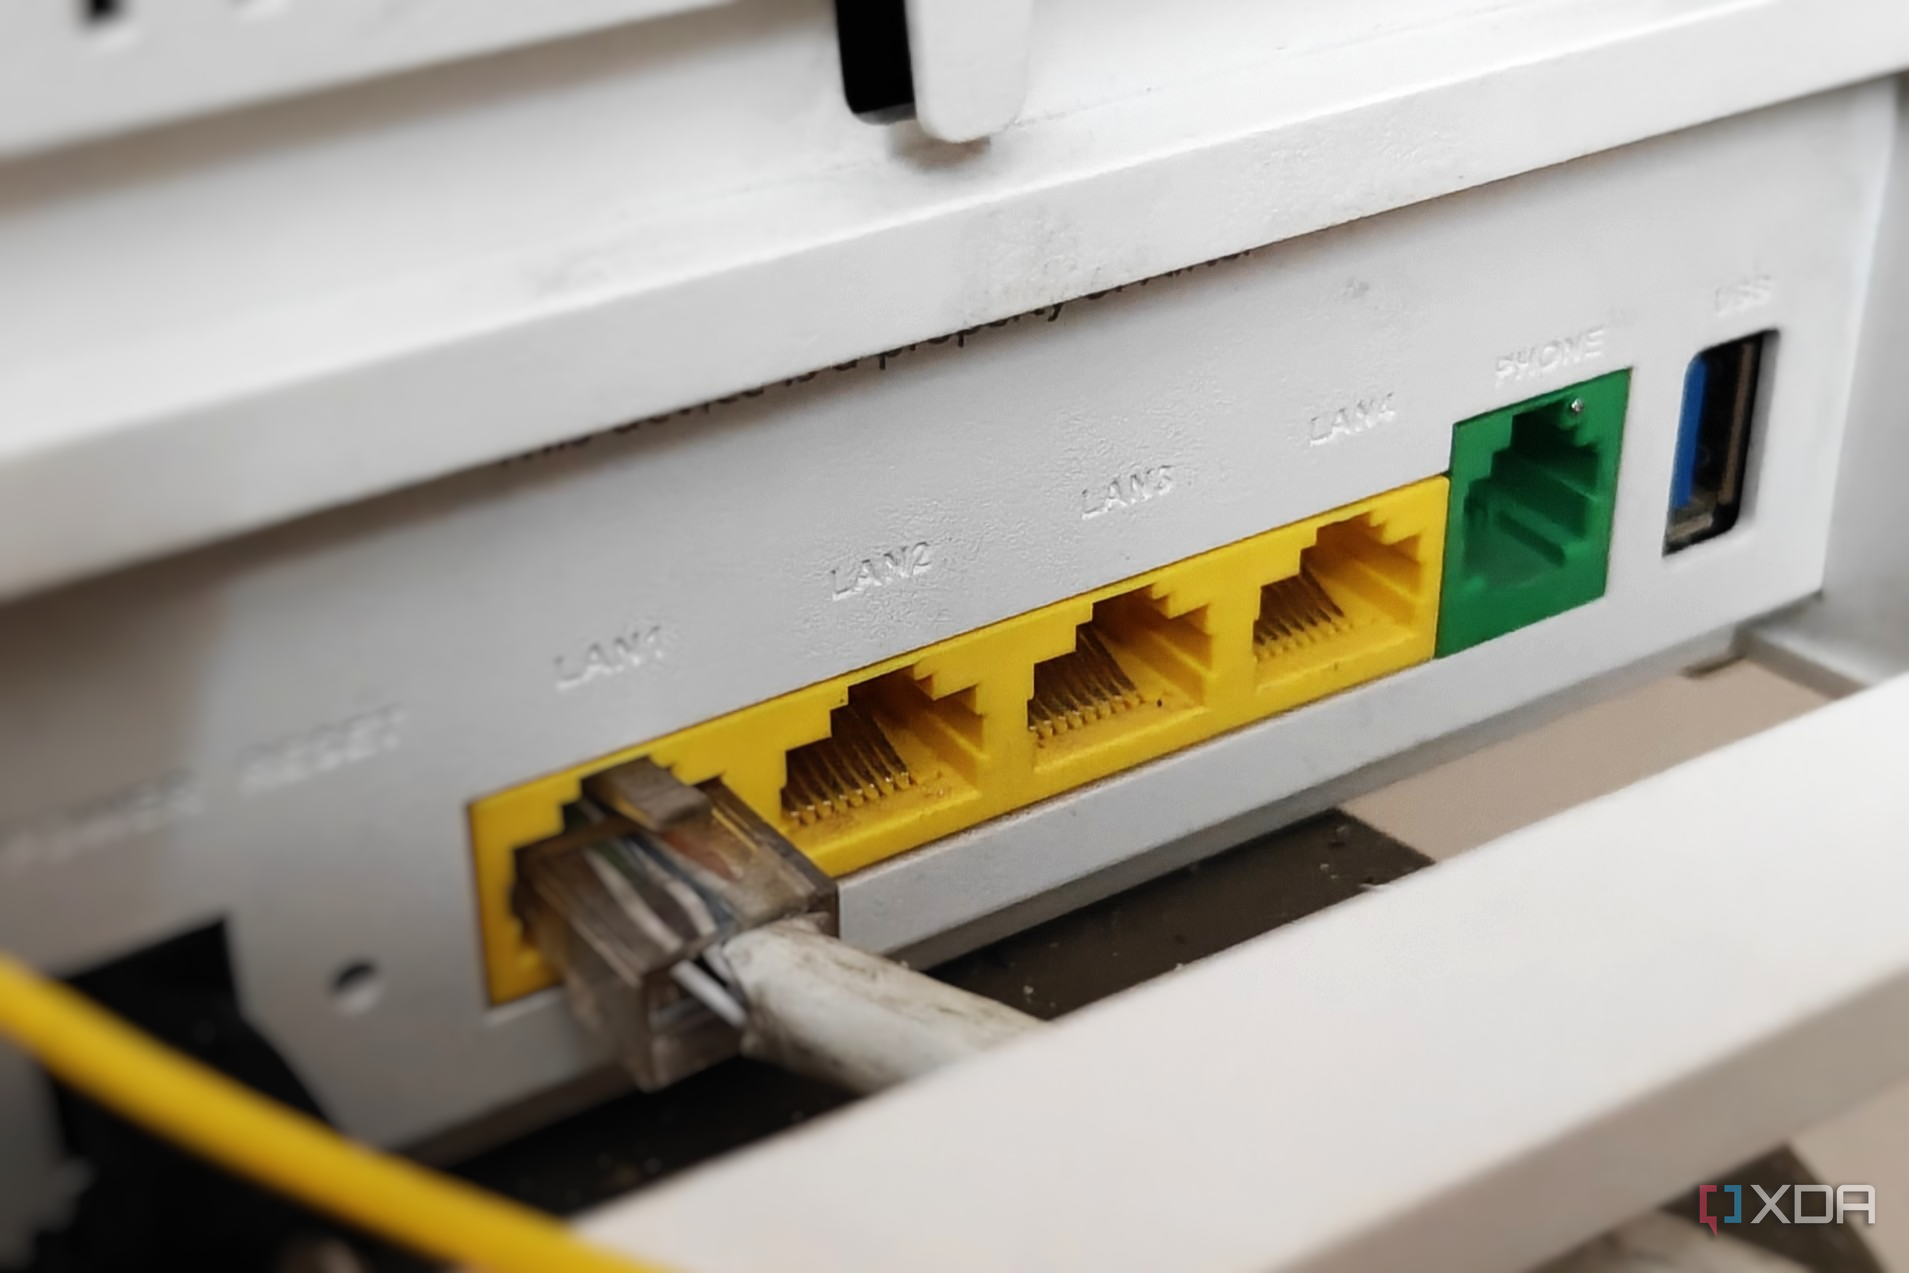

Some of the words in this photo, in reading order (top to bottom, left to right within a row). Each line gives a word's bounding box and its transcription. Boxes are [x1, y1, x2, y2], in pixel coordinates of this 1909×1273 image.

[1495, 324, 1606, 387] PHONE
[1309, 391, 1396, 447] LAN4
[1081, 464, 1172, 520] LAN3
[830, 541, 931, 601] LAN2
[554, 624, 664, 691] LAN1
